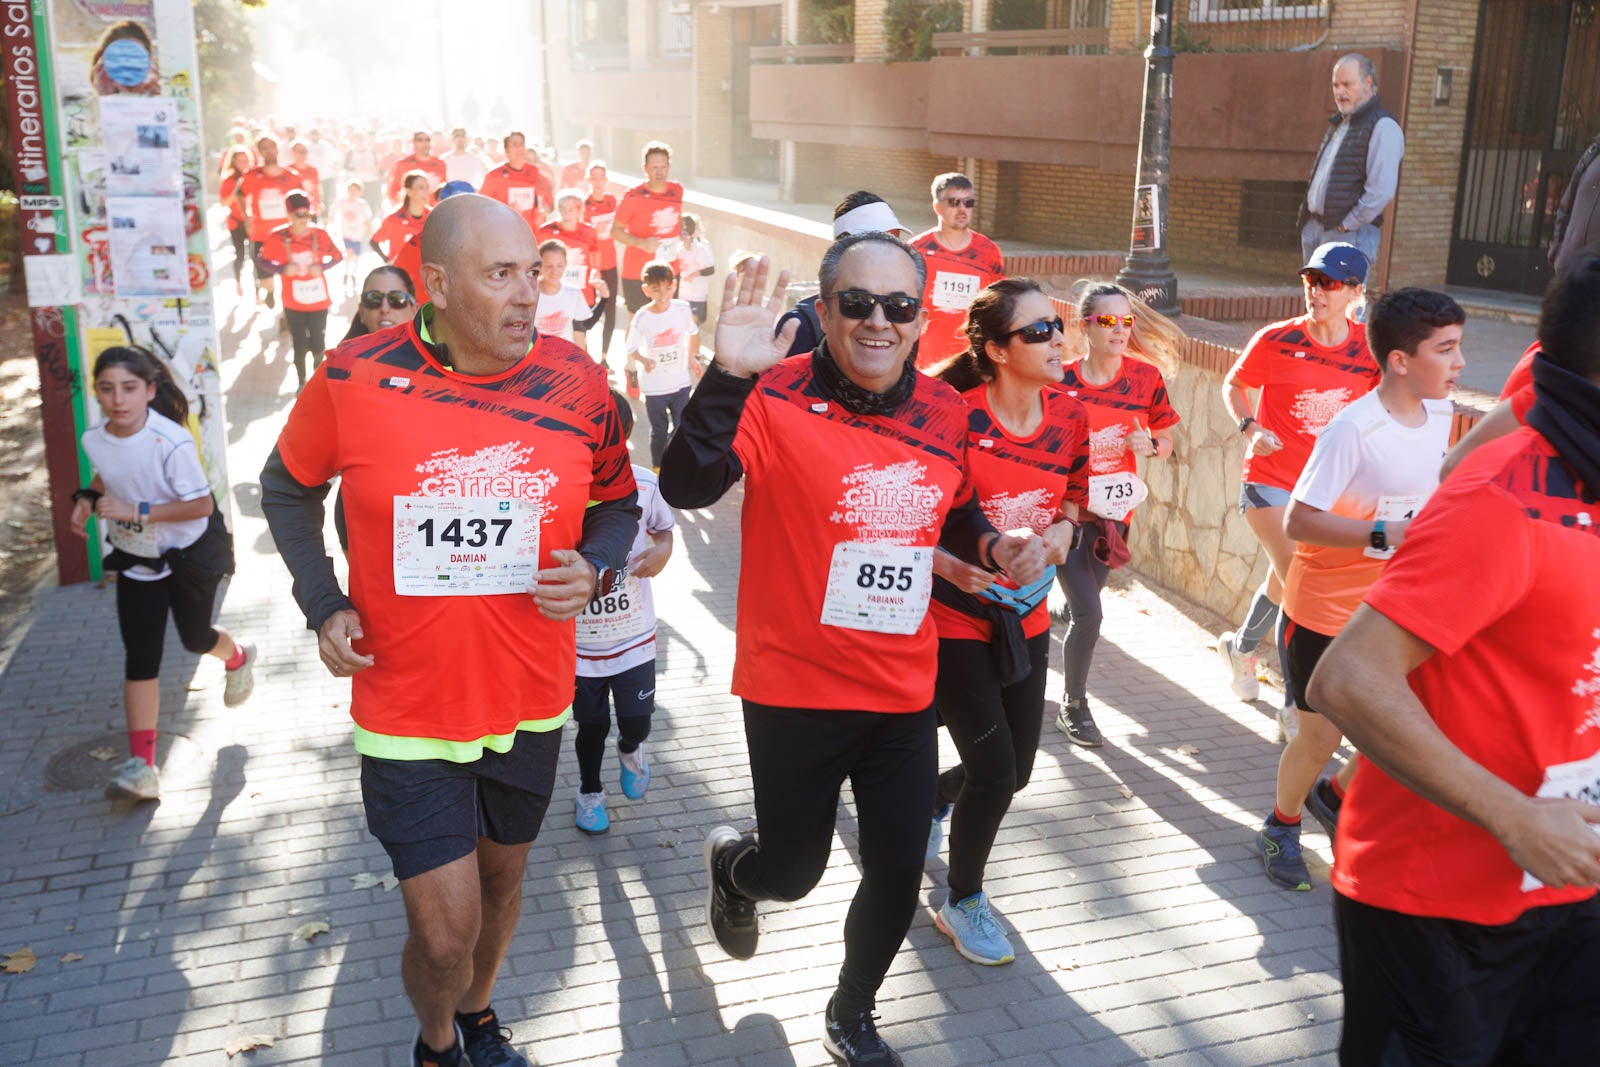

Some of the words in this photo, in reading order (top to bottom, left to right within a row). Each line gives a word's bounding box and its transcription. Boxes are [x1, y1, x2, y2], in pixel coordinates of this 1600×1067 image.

[943, 281, 971, 293] 1191
[421, 476, 546, 498] carrera
[1104, 482, 1133, 500] 733
[845, 488, 935, 508] carrera
[844, 511, 931, 526] cruzroja.es
[417, 518, 513, 547] 1437
[450, 553, 487, 563] DAMIAN
[856, 563, 914, 592] 855
[867, 594, 905, 606] FABIANUS
